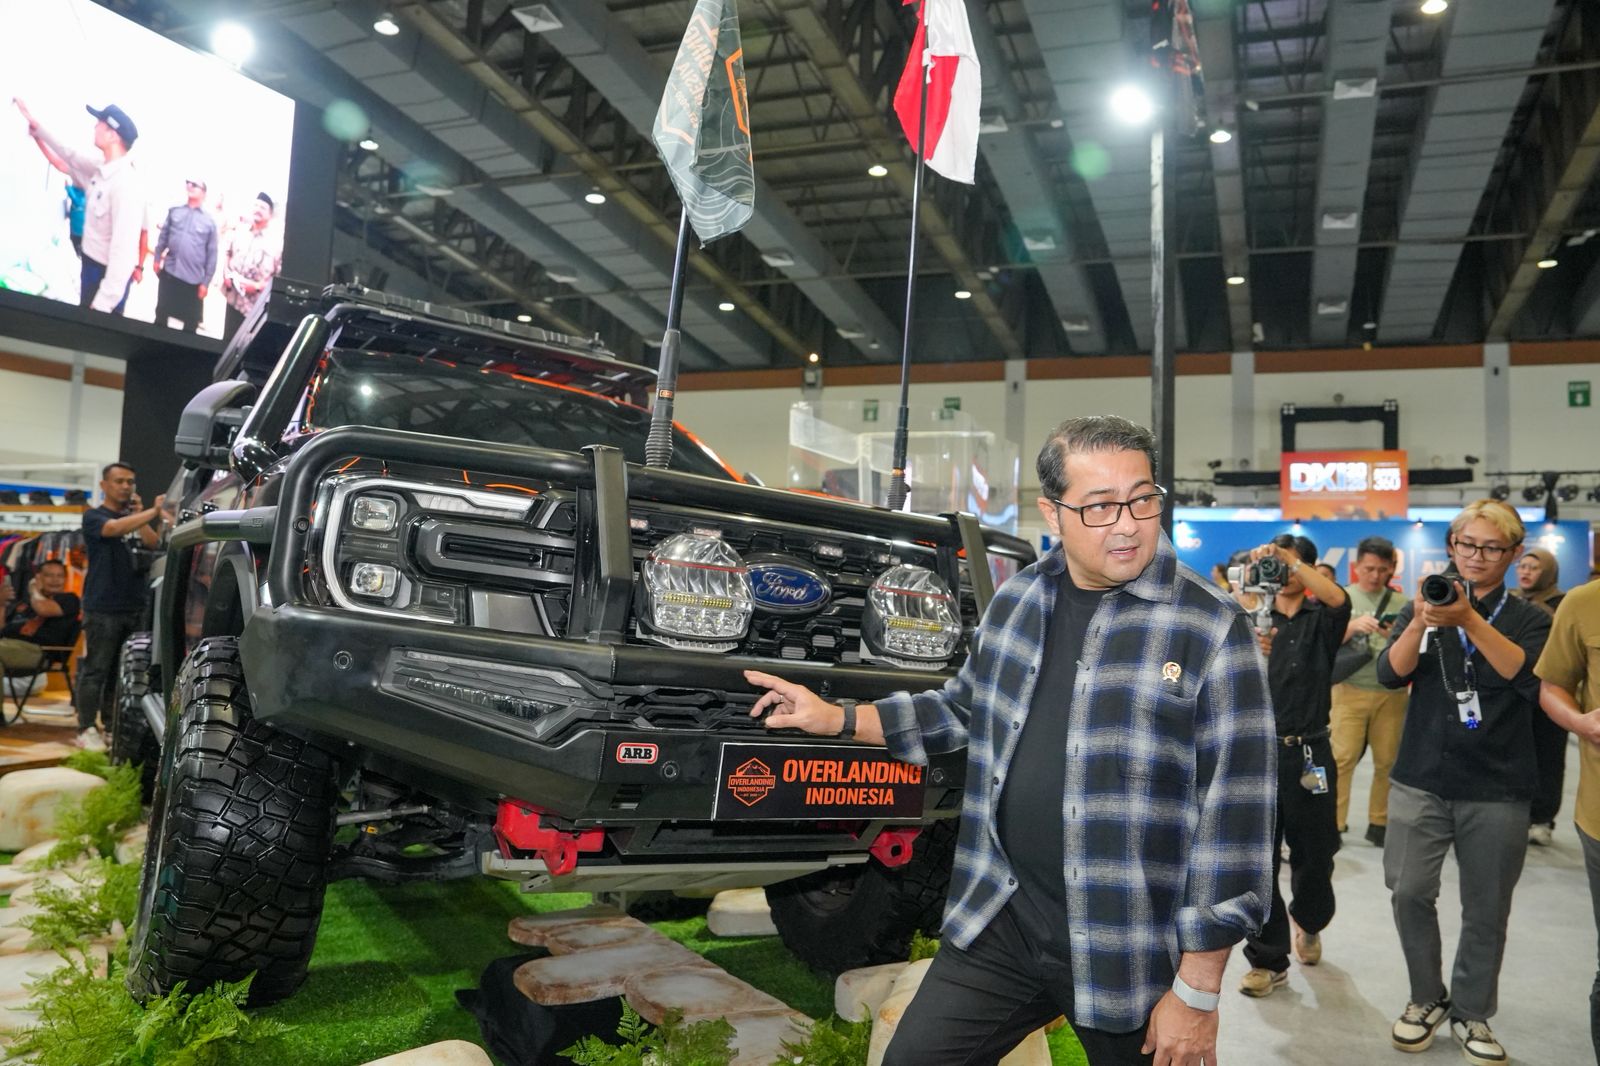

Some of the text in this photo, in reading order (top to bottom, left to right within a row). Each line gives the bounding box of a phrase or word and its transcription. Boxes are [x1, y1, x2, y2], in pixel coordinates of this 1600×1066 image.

[756, 571, 810, 601] Ford
[622, 747, 653, 759] ARB
[783, 759, 922, 785] OVERLANDING
[730, 778, 775, 786] OVERLANDING
[805, 787, 895, 806] INDONESIA
